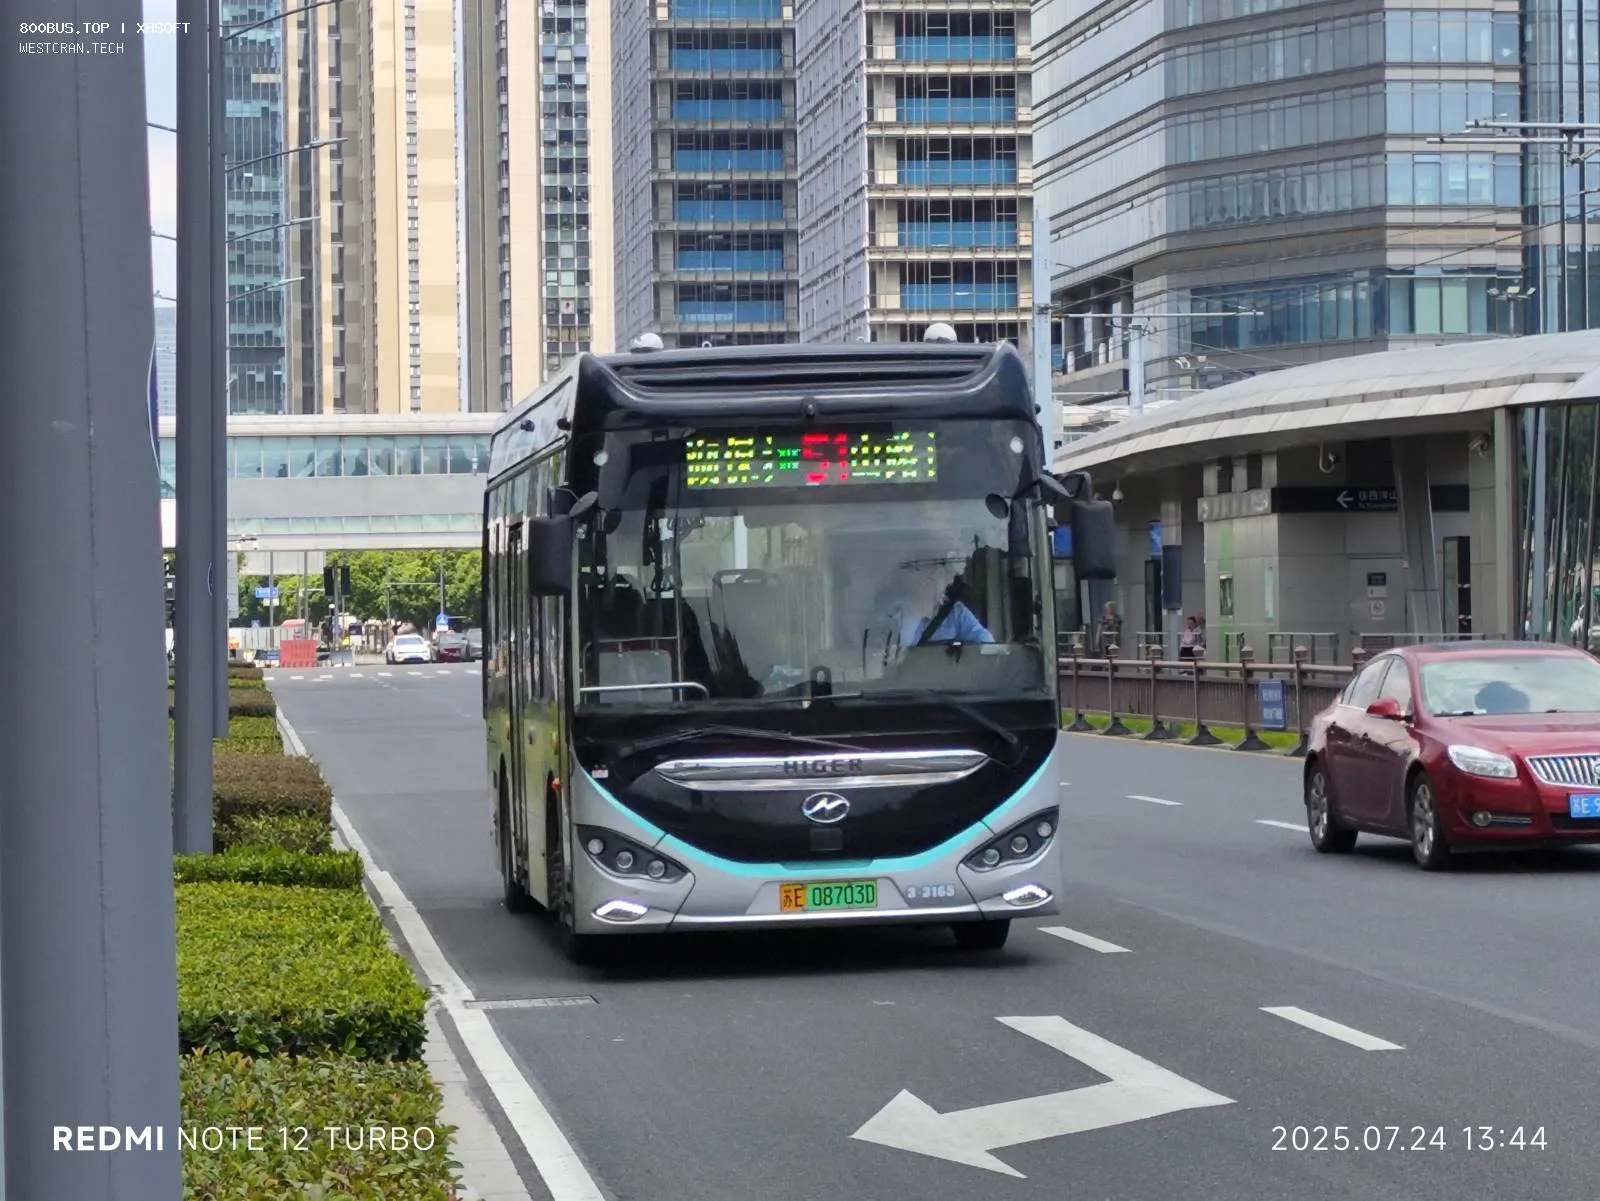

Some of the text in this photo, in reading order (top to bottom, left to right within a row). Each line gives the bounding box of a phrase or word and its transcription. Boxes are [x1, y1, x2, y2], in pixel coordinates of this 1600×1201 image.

[802, 433, 848, 482] 51
[783, 758, 863, 774] HIGER
[783, 884, 875, 908] 苏E 08703D
